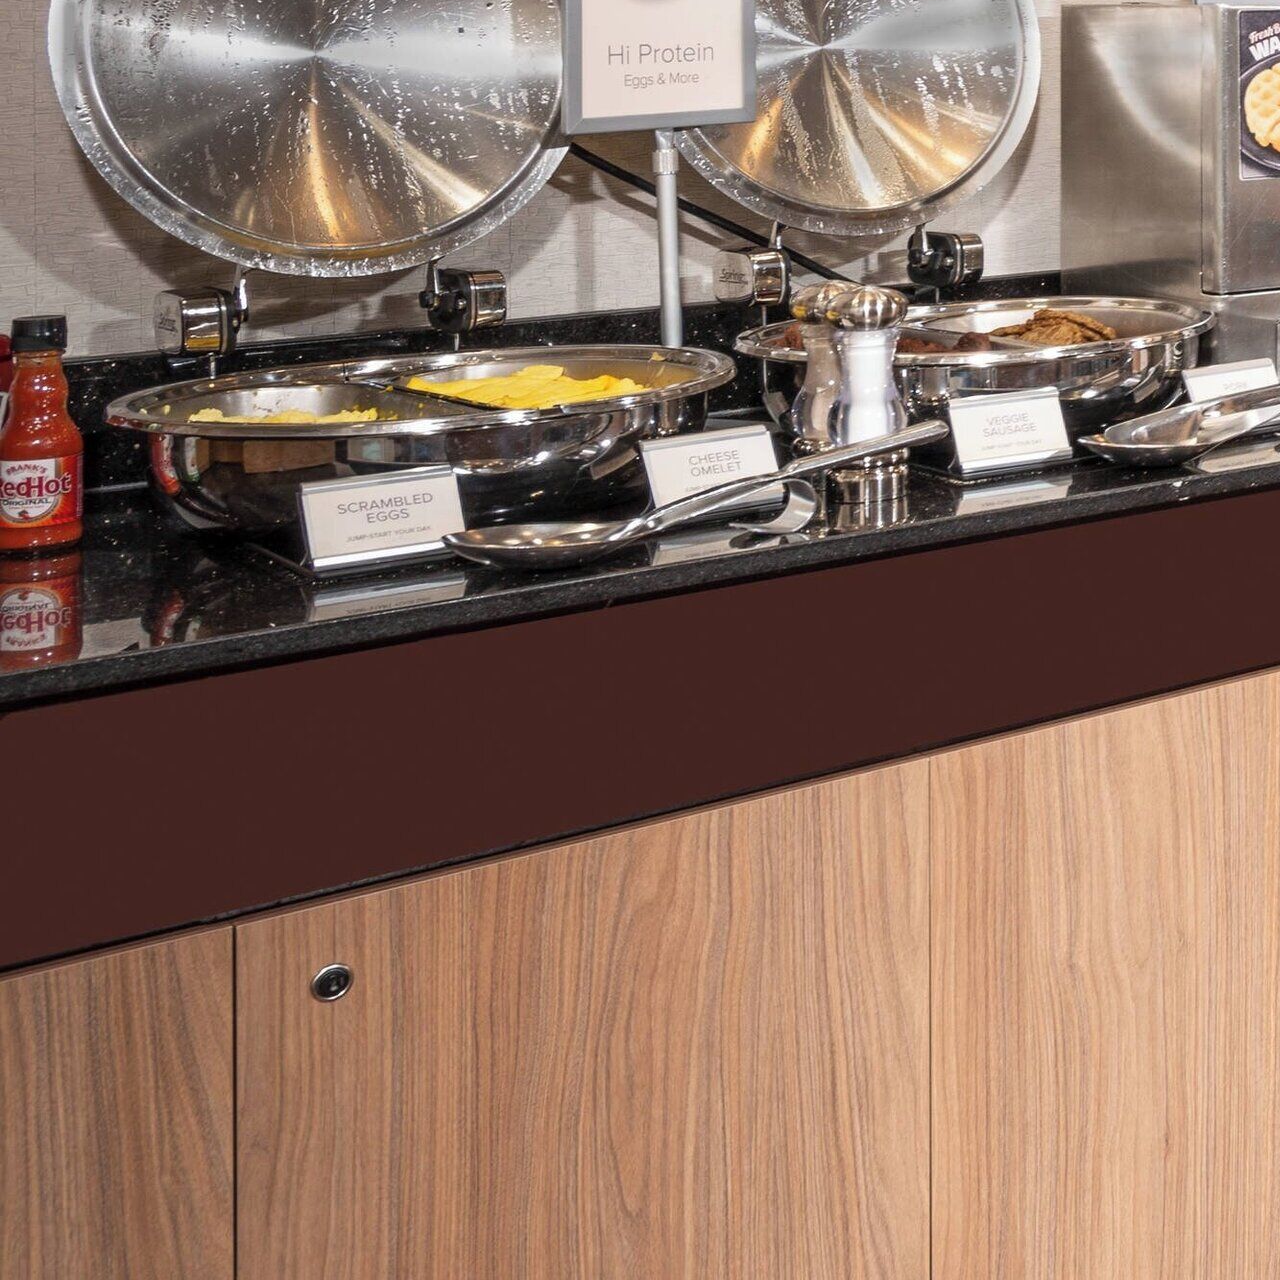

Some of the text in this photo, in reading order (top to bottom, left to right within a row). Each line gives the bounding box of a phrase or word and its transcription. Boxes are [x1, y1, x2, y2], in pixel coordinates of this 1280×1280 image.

[1248, 26, 1274, 43] Fresh
[608, 42, 714, 65] Hi Protein
[624, 72, 700, 89] Eggs & More
[986, 412, 1029, 426] VEGGIE
[982, 423, 1037, 438] SAUSAGE
[688, 450, 740, 466] CHEESE
[690, 461, 742, 477] OMELET
[337, 492, 433, 515] SCRAMBLED
[366, 508, 410, 524] EGGS
